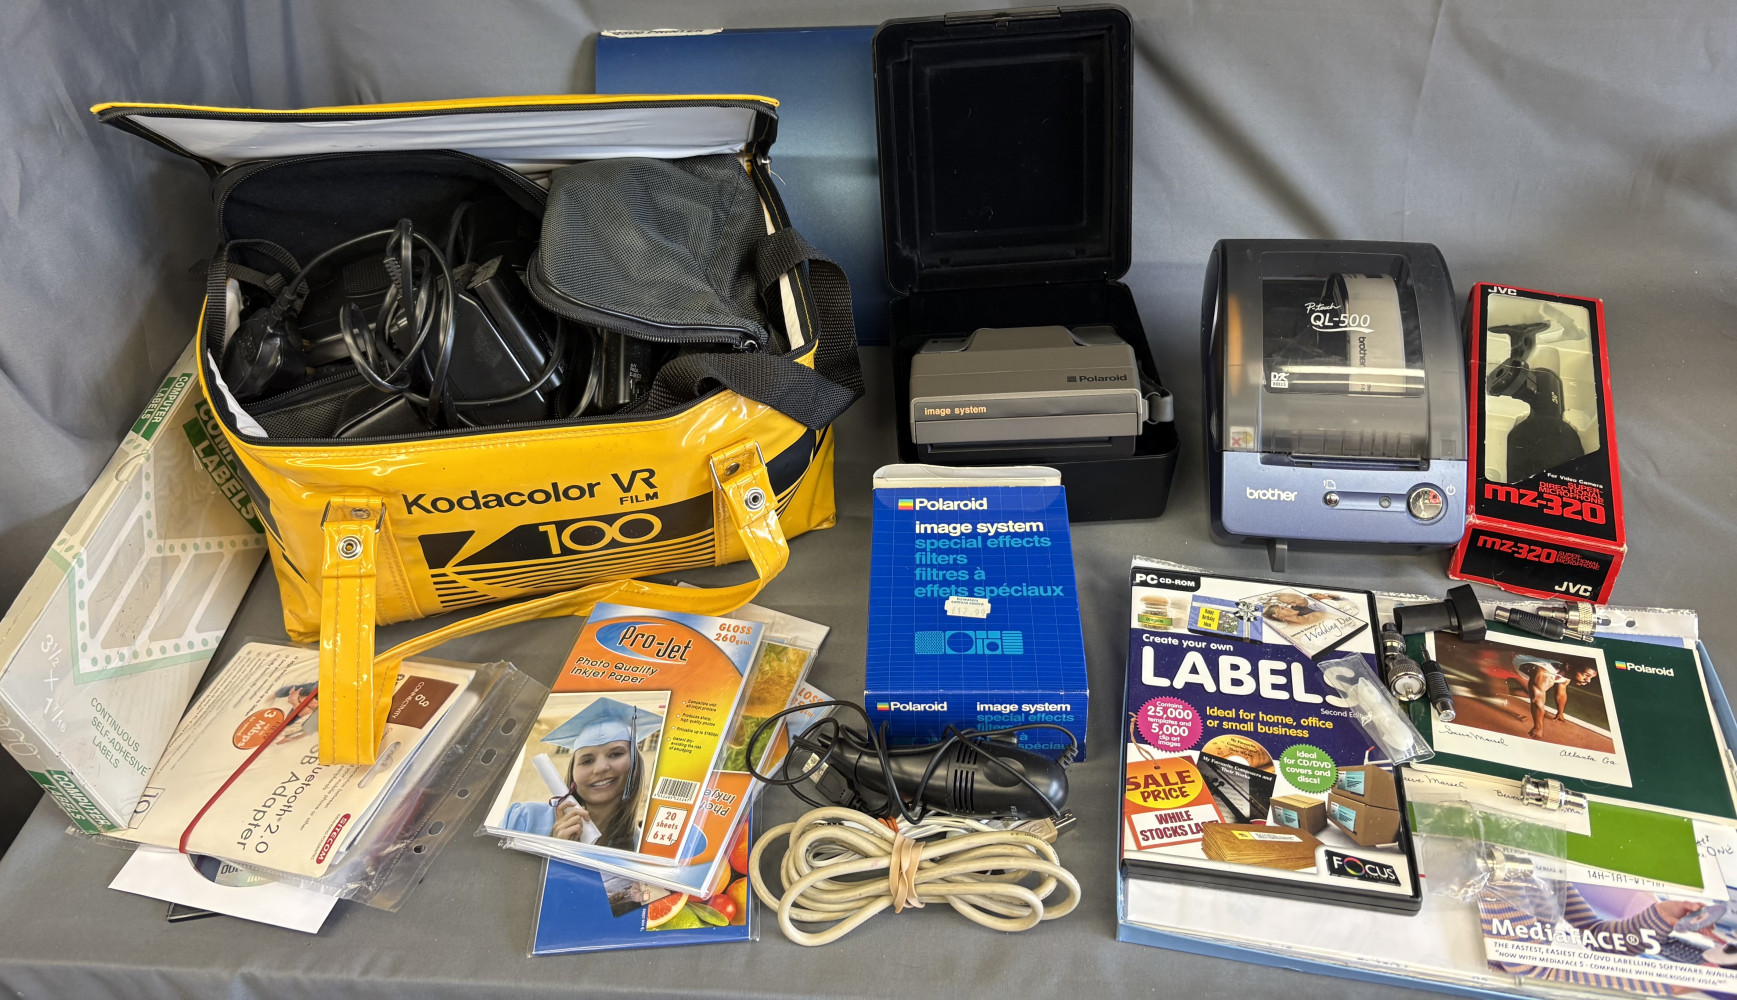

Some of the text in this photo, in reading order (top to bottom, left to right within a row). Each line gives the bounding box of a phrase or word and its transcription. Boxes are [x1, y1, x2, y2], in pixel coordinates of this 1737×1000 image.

[1488, 286, 1517, 296] JVC
[1304, 302, 1341, 313] P-touch
[1310, 312, 1370, 327] QL-500
[1079, 374, 1127, 382] Polaroid
[141, 386, 170, 420] LABELS
[152, 375, 188, 424] COMPUTER
[924, 405, 986, 416] image system
[196, 440, 255, 520] LABELS
[1560, 475, 1576, 483] Video
[1578, 480, 1604, 488] Camera
[402, 468, 658, 514] Kodacolor VR
[1246, 487, 1298, 502] brother
[1539, 487, 1604, 505] MICROPHONE
[1540, 482, 1601, 498] DIRECTIONAL
[620, 492, 659, 506] FILM
[915, 498, 988, 510] Polaroid
[539, 513, 662, 555] 100
[915, 520, 1044, 536] image system
[915, 535, 1052, 551] special effects
[915, 551, 968, 565] filters
[915, 566, 986, 580] filtres à
[1135, 574, 1196, 588] PC CD-ROM
[914, 582, 1064, 598] effets spéciaux
[1554, 582, 1592, 597] JVC
[718, 623, 752, 635] GLOSS
[1305, 621, 1341, 642] Wedding
[617, 626, 692, 662] Pro-Jet
[1142, 634, 1179, 646] Create
[1182, 640, 1206, 648] your
[576, 656, 658, 677] Photo Quality
[1626, 662, 1675, 678] Polaroid
[570, 666, 646, 684] Inkjet Paper
[1141, 646, 1359, 708] LABELS
[392, 682, 425, 720] CONNECTIVITY
[890, 702, 948, 712] Polaroid
[976, 702, 1071, 714] image system
[1156, 701, 1183, 710] Contains
[976, 713, 1074, 723] special effects
[1147, 706, 1192, 720] 25,000
[1206, 706, 1334, 729] Ideal for home, office
[1320, 707, 1347, 718] Second
[90, 697, 140, 752] CONTINUOUS
[1148, 717, 1178, 726] templates
[1151, 723, 1188, 736] 5,000
[1206, 719, 1310, 738] or small business
[236, 720, 268, 750] Mbps
[1159, 734, 1170, 742] clip
[91, 716, 149, 778] SELF-ADHESIVE
[1158, 740, 1181, 748] images
[92, 736, 120, 769] LABELS
[1296, 750, 1317, 759] Ideal
[1211, 758, 1234, 769] Favourite
[1234, 766, 1262, 778] Composers
[1297, 758, 1331, 769] CD/DVD
[1126, 770, 1195, 791] SALE
[1298, 775, 1320, 784] discs!
[42, 784, 86, 820] LABELS
[53, 774, 111, 826] COMPUTER
[704, 788, 736, 805] Inkje
[1140, 786, 1190, 803] PRICE
[237, 772, 300, 850] Adapter
[665, 811, 677, 821] 20
[700, 802, 731, 818] Pho
[1155, 810, 1193, 825] WHILE
[656, 820, 678, 830] sheets
[1140, 824, 1189, 842] STOCKS
[255, 824, 280, 854] 2.0
[317, 816, 348, 863] SITECOM
[653, 831, 659, 840] 6
[667, 833, 673, 842] 4
[1333, 856, 1396, 880] FOCUS
[1640, 929, 1661, 954] 5
[1512, 944, 1544, 955] FASTEST,
[1546, 949, 1576, 958] EASIEST
[1578, 952, 1611, 962] CD/DVD
[1613, 957, 1657, 969] LABELLING
[1659, 963, 1703, 975] SOFTWARE
[1518, 954, 1538, 962] WITH
[1539, 956, 1578, 968] MEDIAFACE
[1590, 964, 1633, 975] COMPATIBLE
[1635, 969, 1654, 978] WITH
[1656, 972, 1696, 982] MICROSOFT
